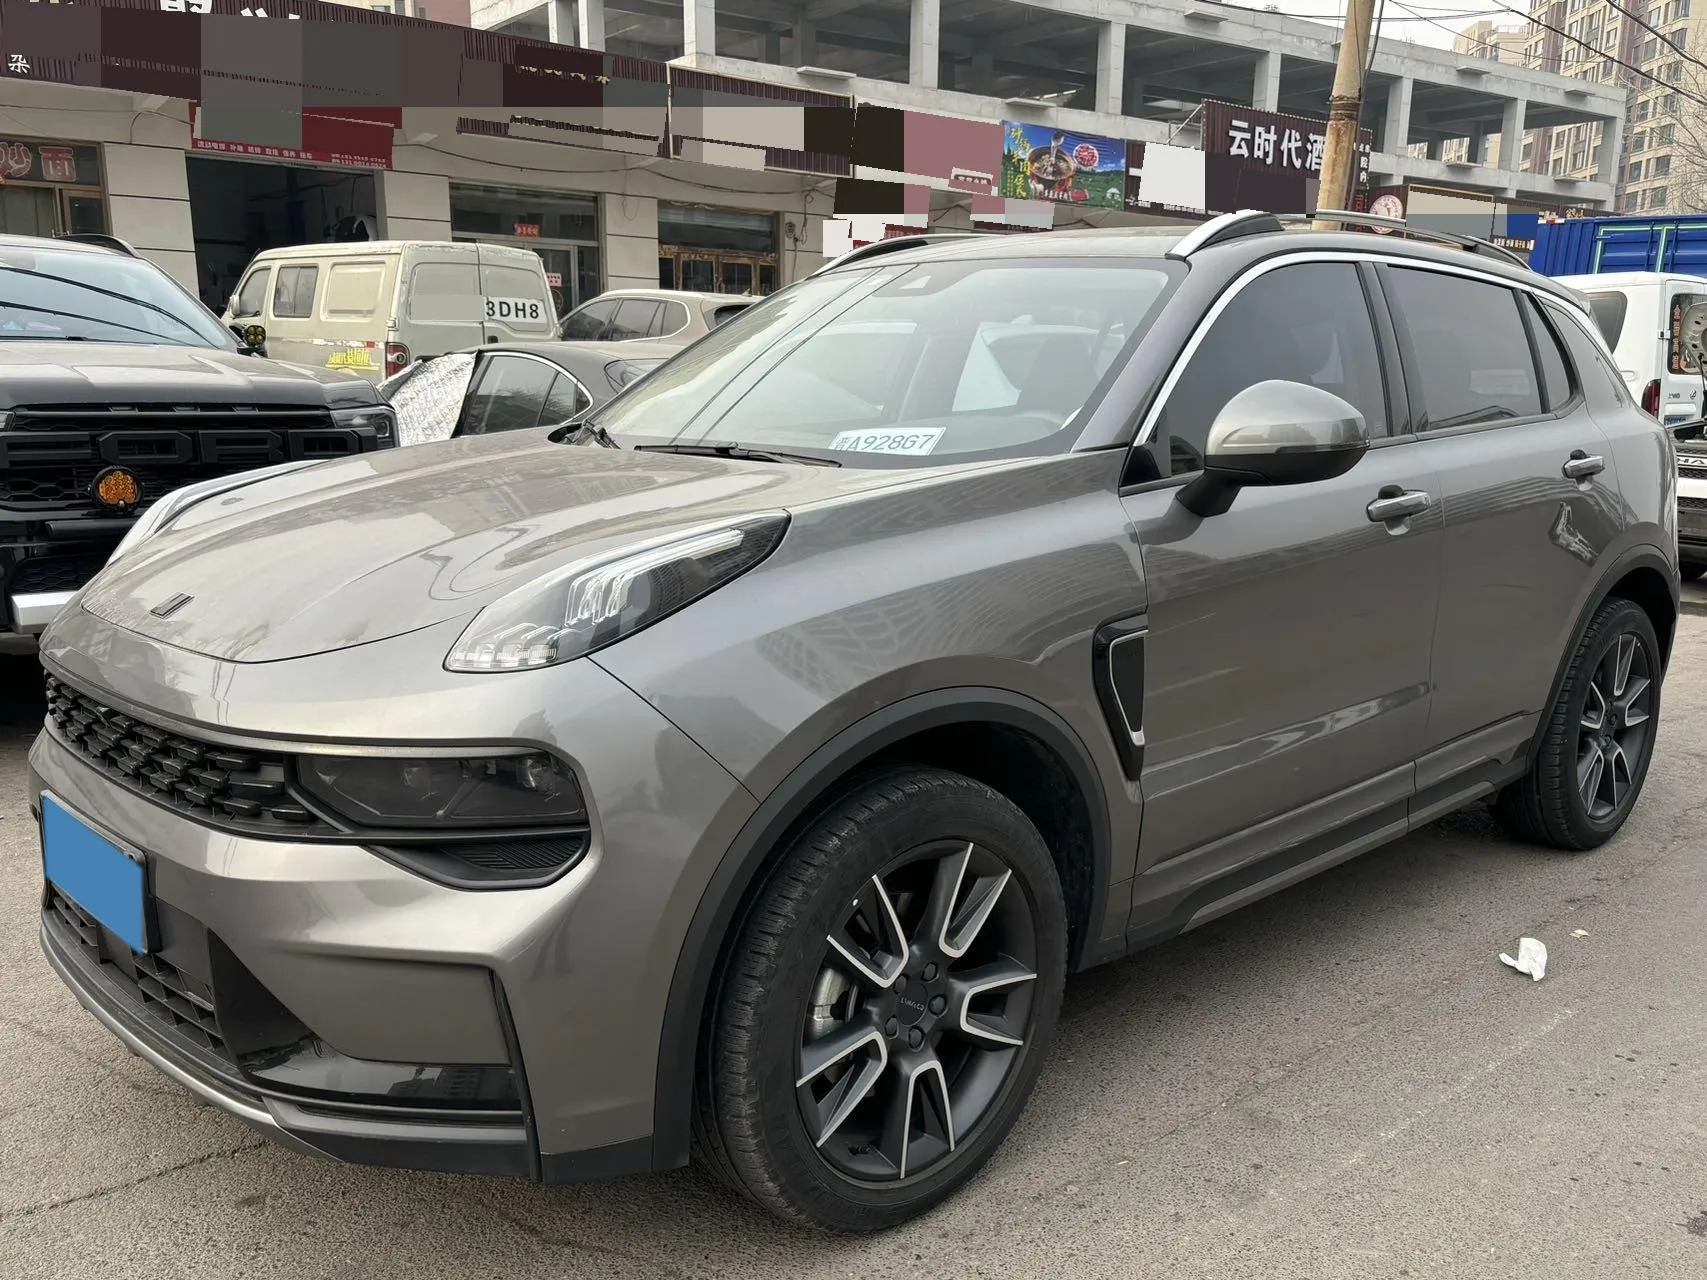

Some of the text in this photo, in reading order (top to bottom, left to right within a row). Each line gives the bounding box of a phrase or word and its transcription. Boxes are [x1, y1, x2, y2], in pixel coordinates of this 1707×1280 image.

[8, 54, 31, 74] 杂
[1228, 119, 1326, 171] 云时代酒
[486, 300, 539, 319] 3DH8
